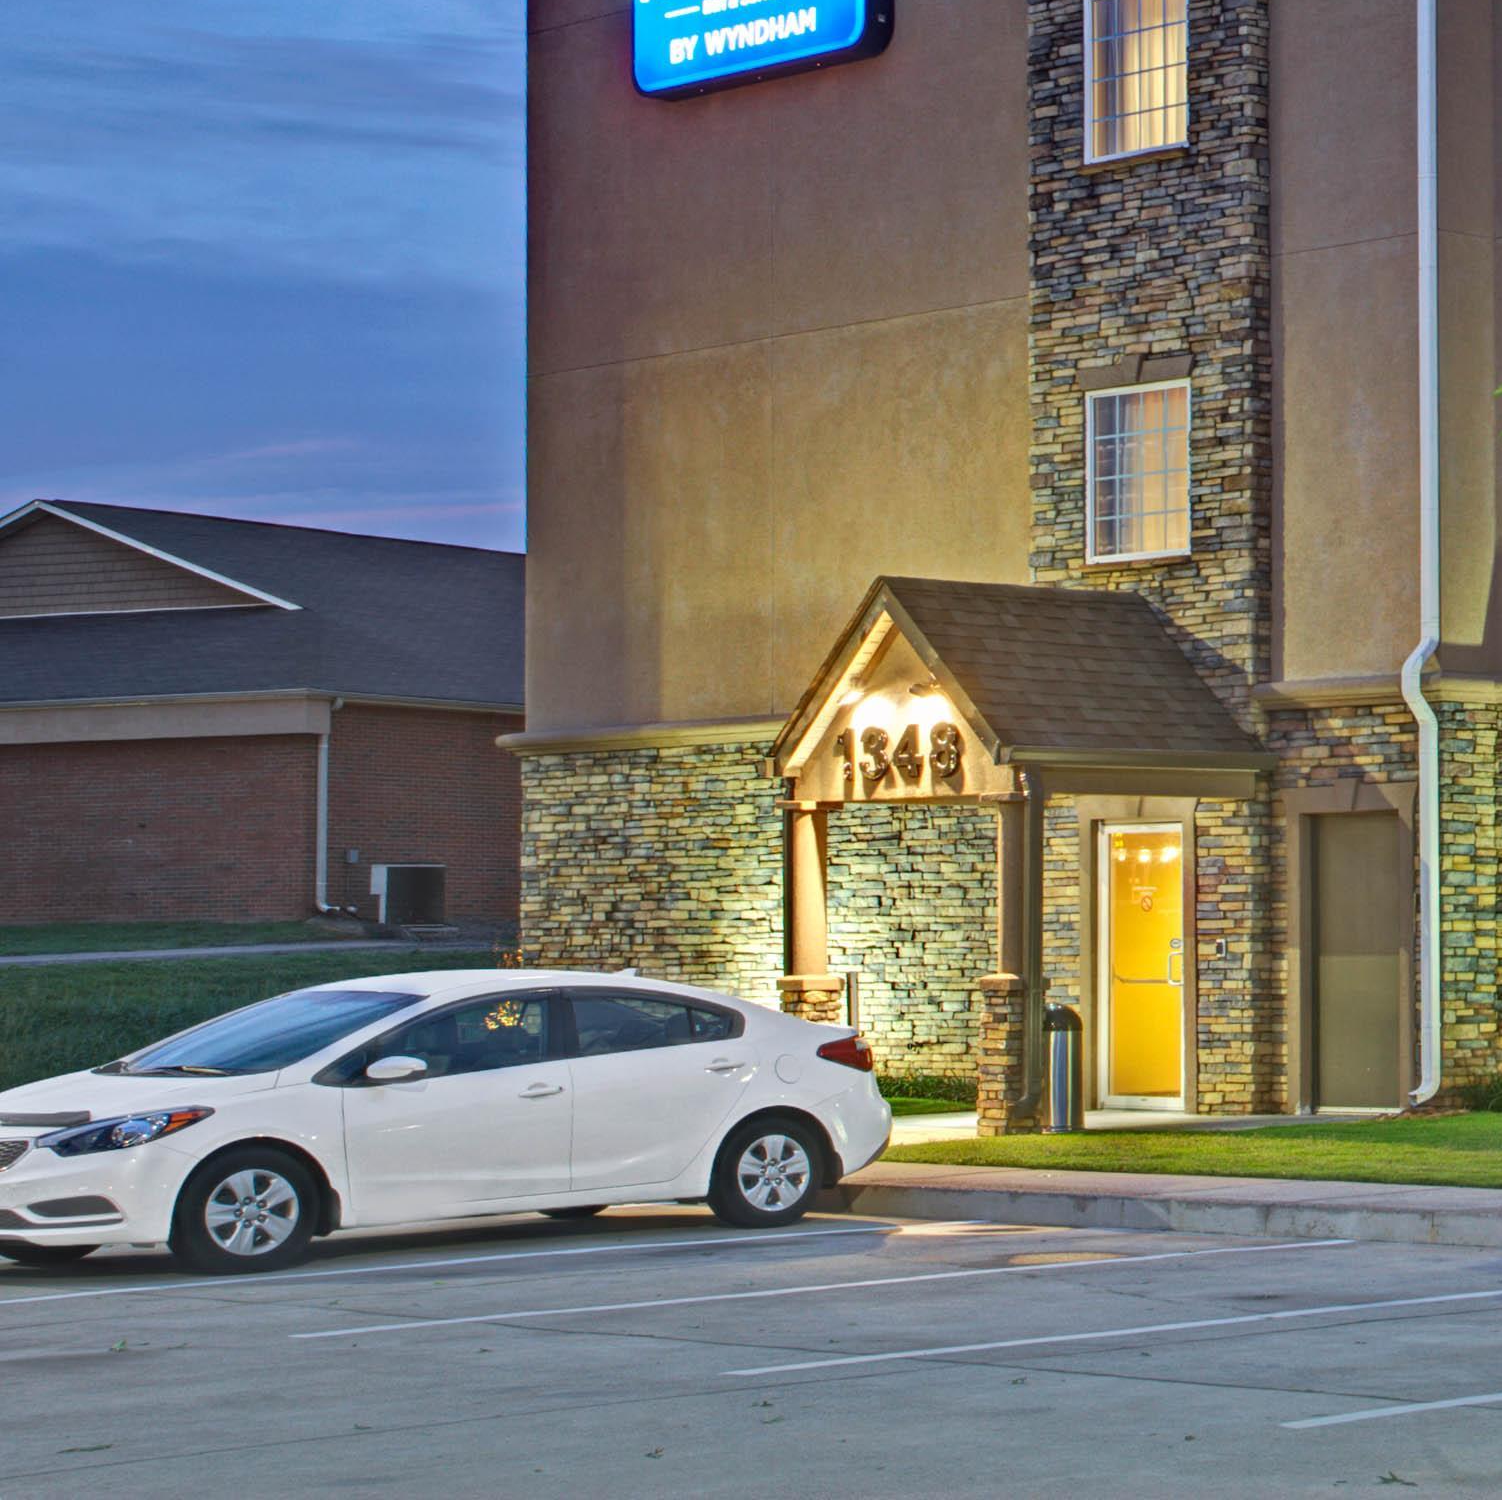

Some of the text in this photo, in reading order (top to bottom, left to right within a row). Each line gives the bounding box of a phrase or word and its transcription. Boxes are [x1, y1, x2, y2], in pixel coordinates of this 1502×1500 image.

[669, 7, 816, 64] BY WYNDHAM
[837, 722, 958, 781] 1348
